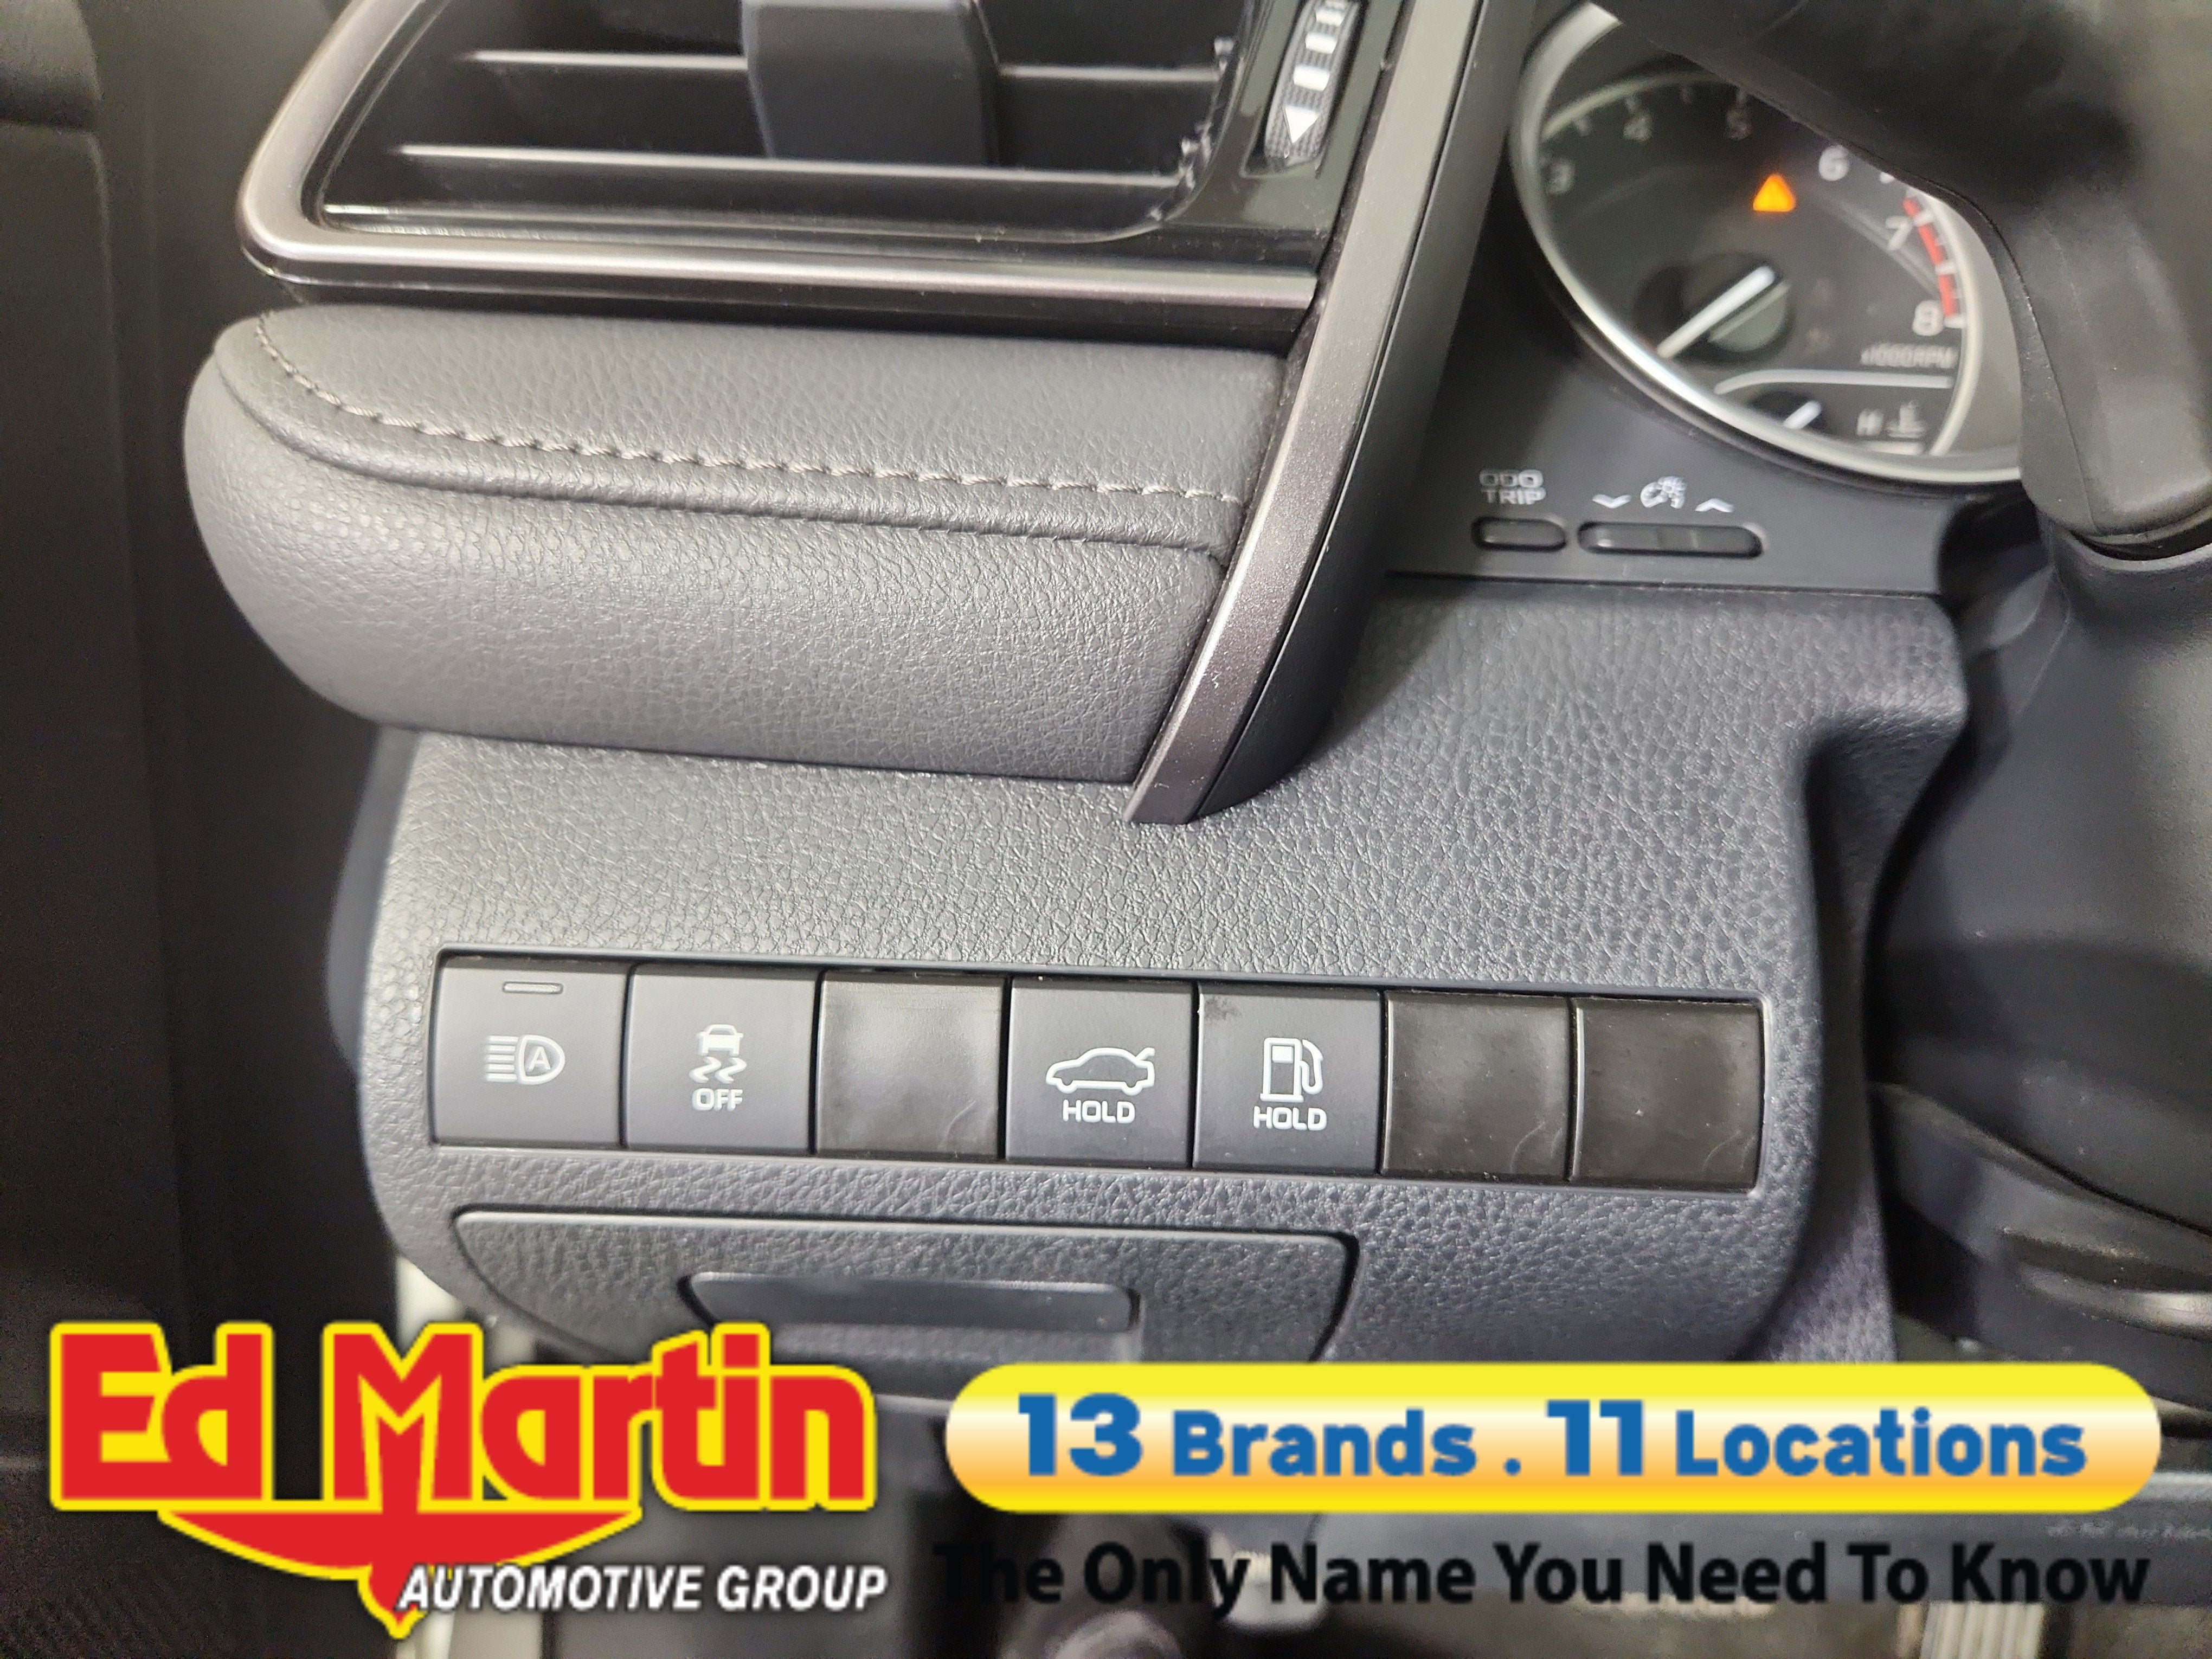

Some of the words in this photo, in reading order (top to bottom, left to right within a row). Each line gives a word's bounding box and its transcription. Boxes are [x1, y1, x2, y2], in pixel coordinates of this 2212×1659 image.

[1818, 145, 1850, 182] 6
[1887, 216, 1914, 252] 7
[1913, 301, 1943, 336] 8
[1479, 470, 1544, 489] ODO
[1486, 489, 1546, 505] TRIP
[530, 1047, 550, 1071] A
[691, 1088, 743, 1111] OFF
[1062, 1099, 1135, 1123] HOLD
[1253, 1106, 1327, 1130] HOLD
